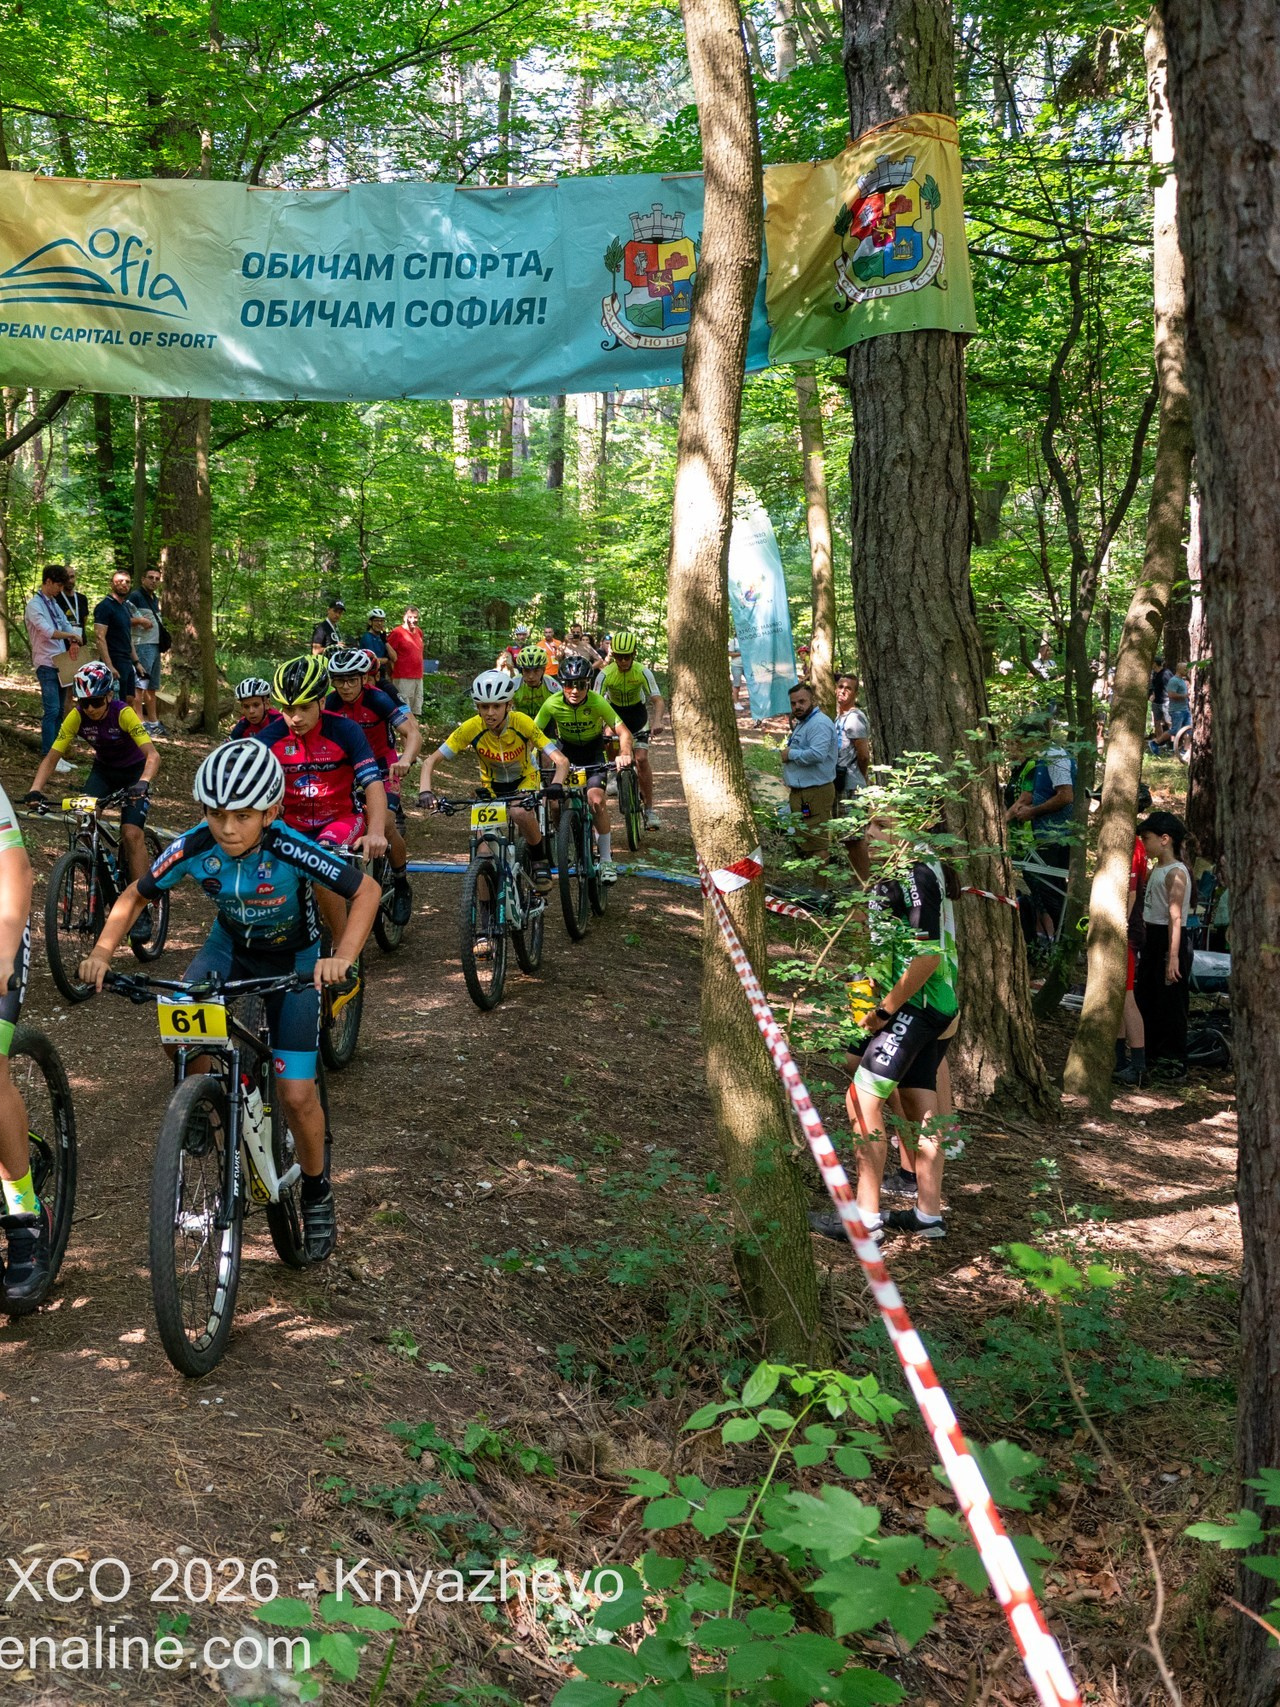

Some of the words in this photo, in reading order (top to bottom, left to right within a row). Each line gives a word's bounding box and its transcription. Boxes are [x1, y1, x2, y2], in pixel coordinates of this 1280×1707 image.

[240, 252, 395, 281] ОБИЧАМ
[404, 249, 554, 283] СПОРТА,
[240, 298, 396, 328] ОБИЧАМ
[404, 296, 547, 330] СОФИЯ!
[49, 326, 124, 345] CAPITAL
[128, 330, 152, 348] OF
[156, 332, 217, 350] SPORT
[644, 338, 662, 346] НО
[478, 808, 499, 823] 62
[273, 837, 342, 882] POMORIE
[171, 1008, 207, 1034] 61
[875, 1011, 914, 1067] BEROE
[233, 1179, 241, 1197] DT
